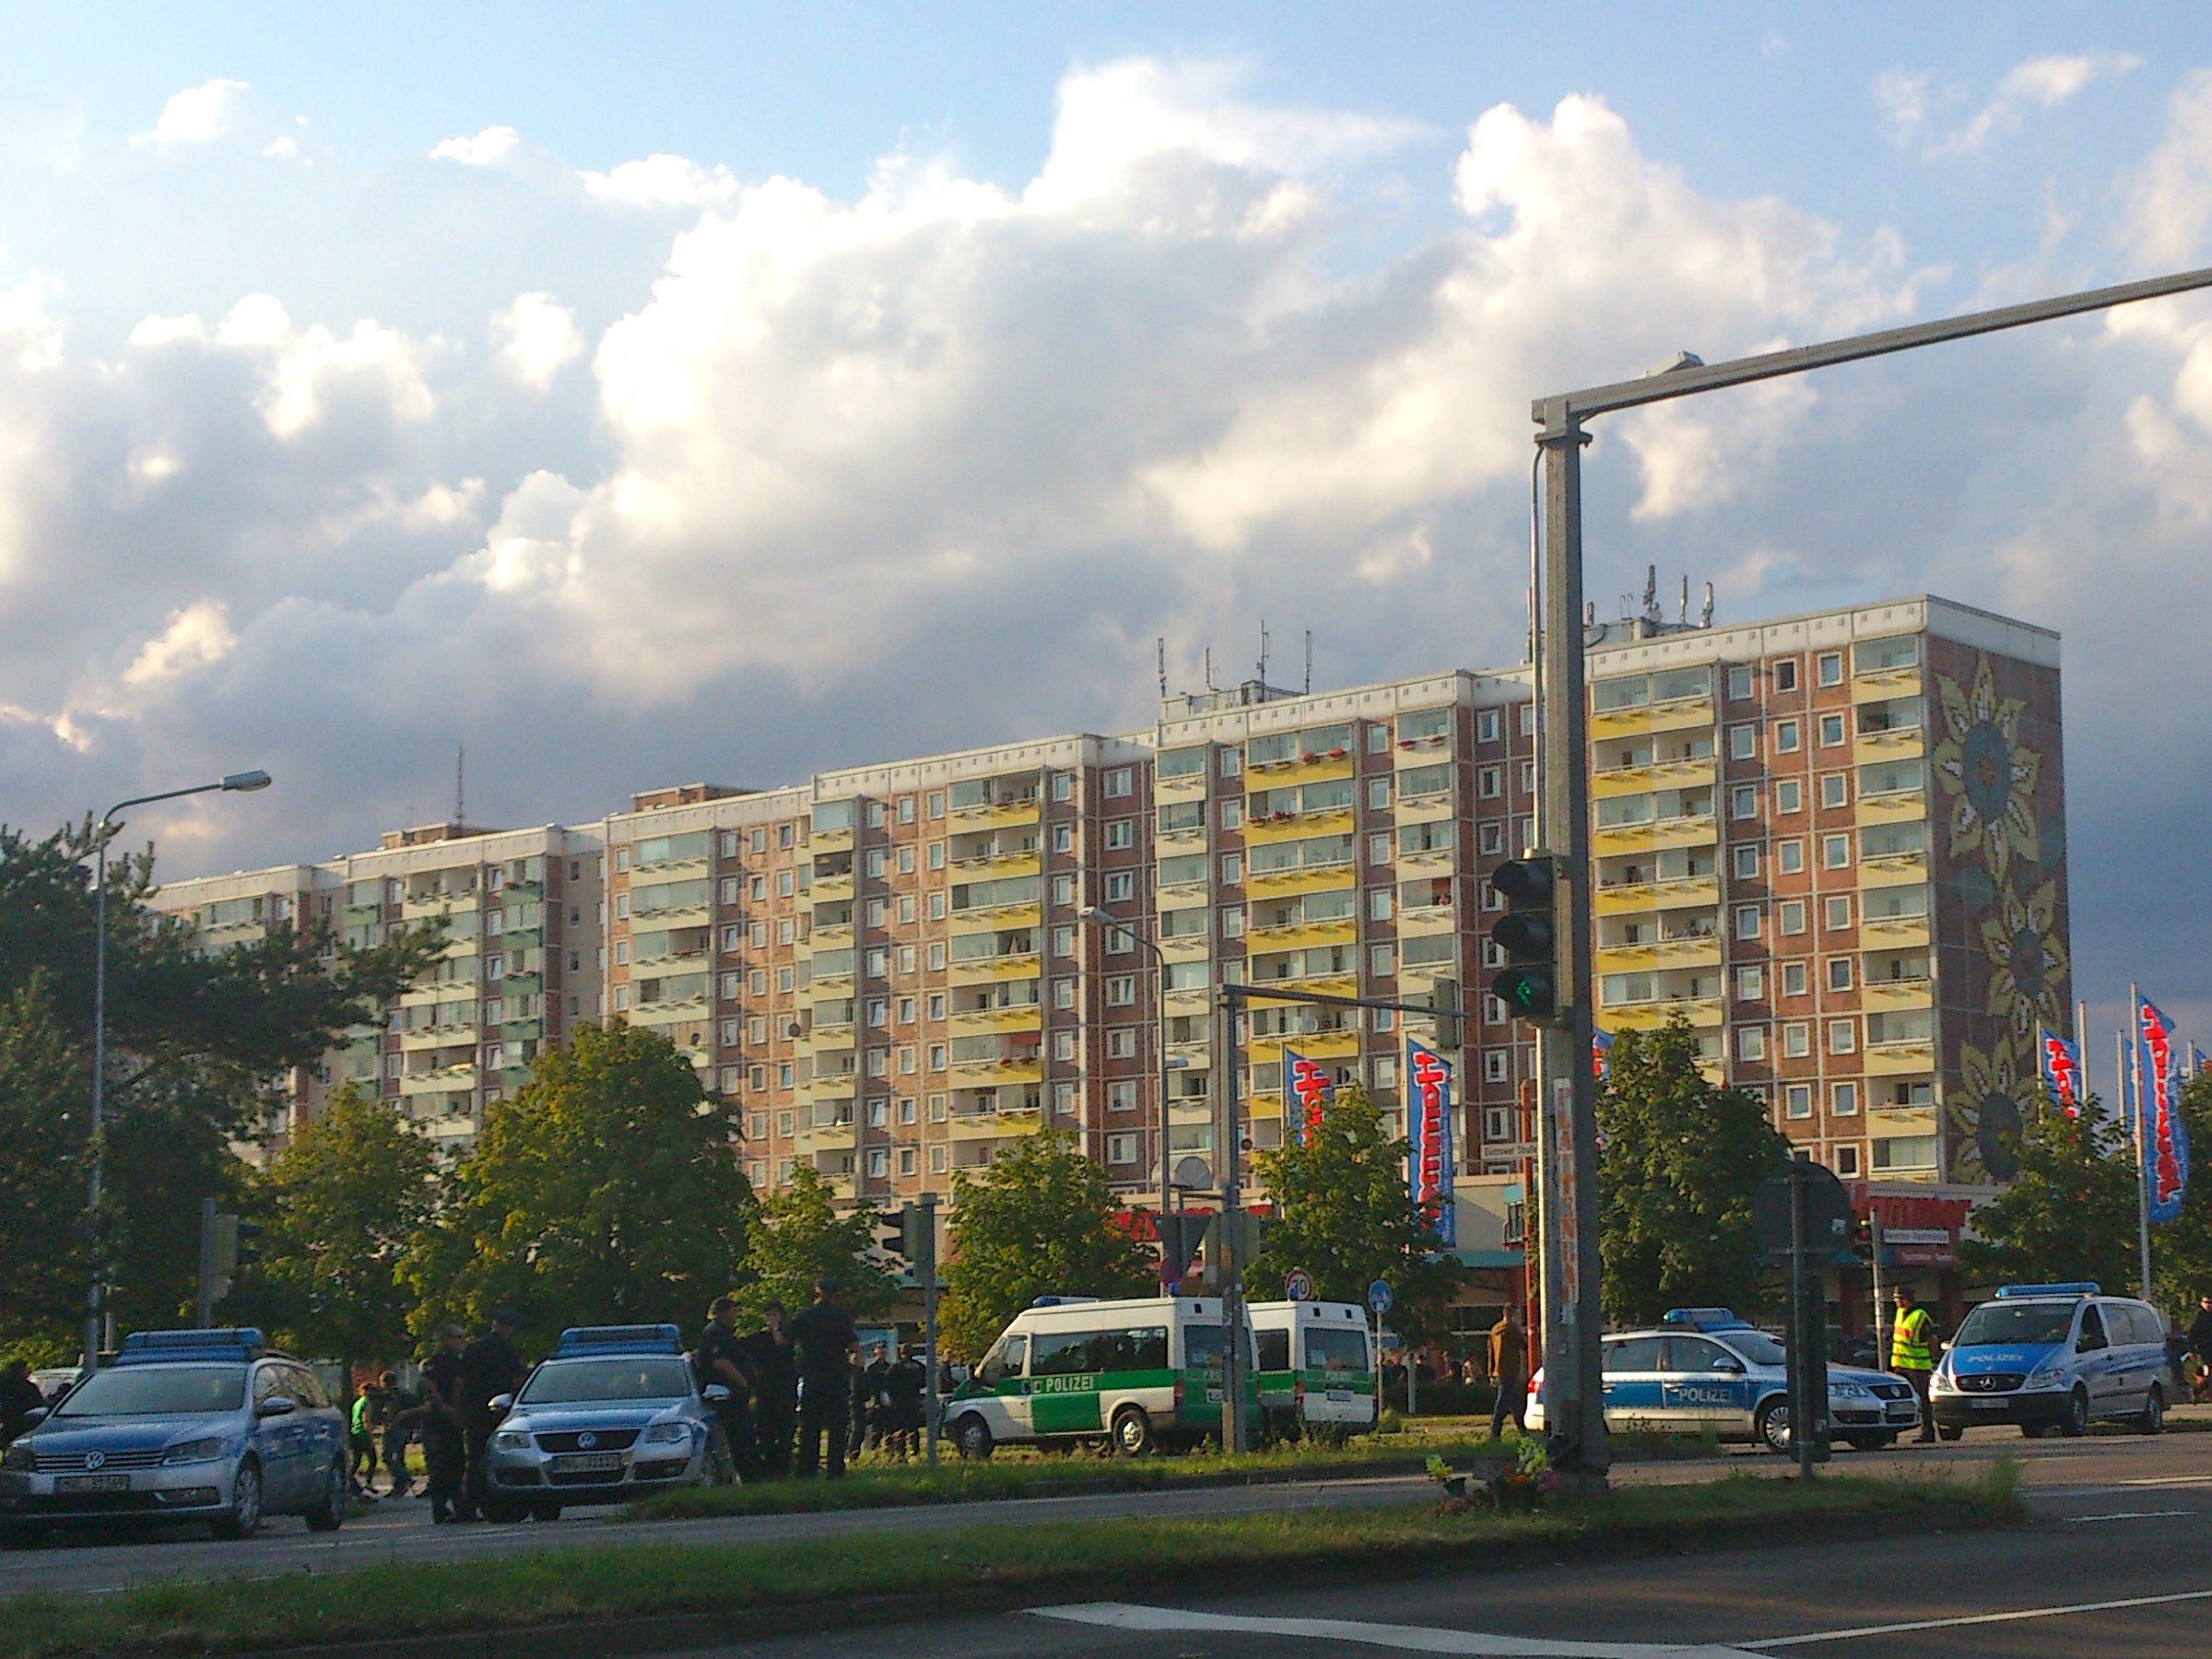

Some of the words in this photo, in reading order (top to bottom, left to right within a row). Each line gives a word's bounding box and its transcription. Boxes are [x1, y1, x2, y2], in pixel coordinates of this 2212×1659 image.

[1968, 1353, 2023, 1363] POLIZEI
[1045, 1375, 1094, 1393] POLIZEI
[1678, 1387, 1733, 1403] POLIZEI
